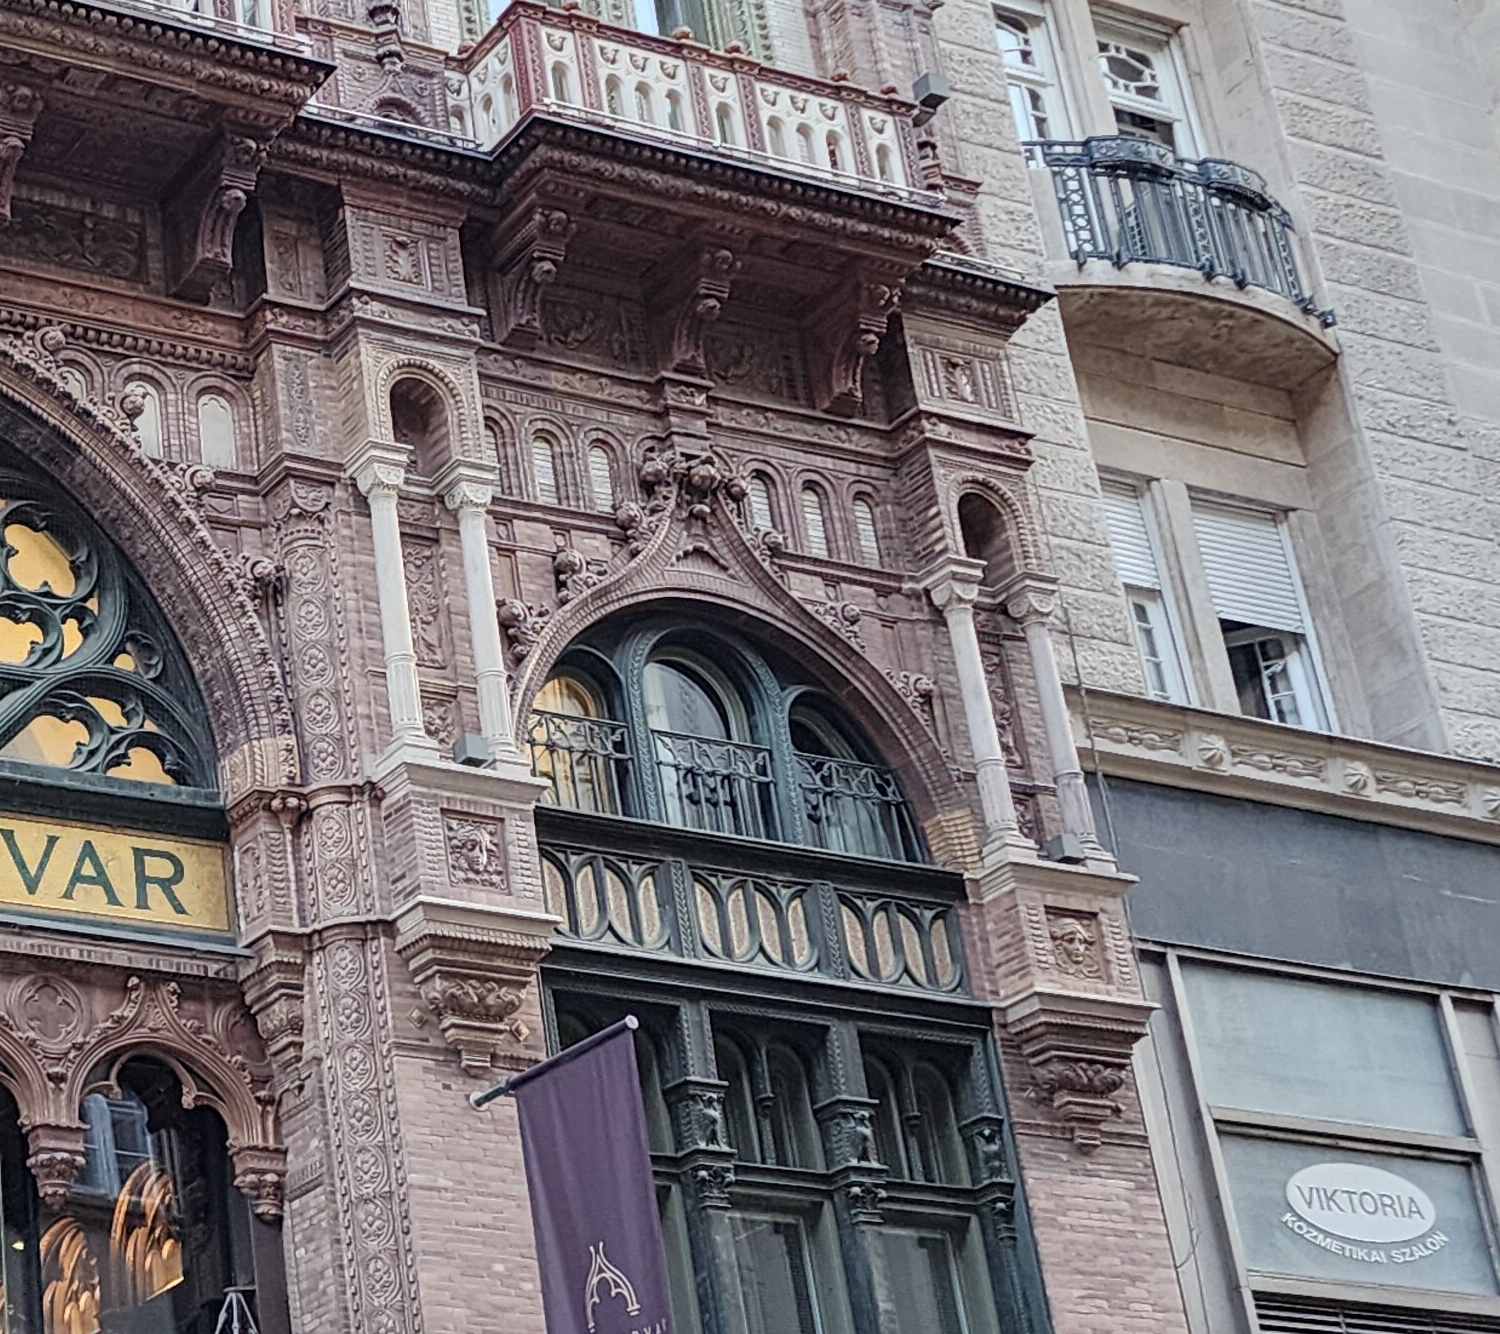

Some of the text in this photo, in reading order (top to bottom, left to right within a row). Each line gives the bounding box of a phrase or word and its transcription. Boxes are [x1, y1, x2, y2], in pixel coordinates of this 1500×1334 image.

[1295, 1184, 1427, 1220] VIKTORIA
[1280, 1212, 1449, 1264] KOZMETIKAI SZALON
